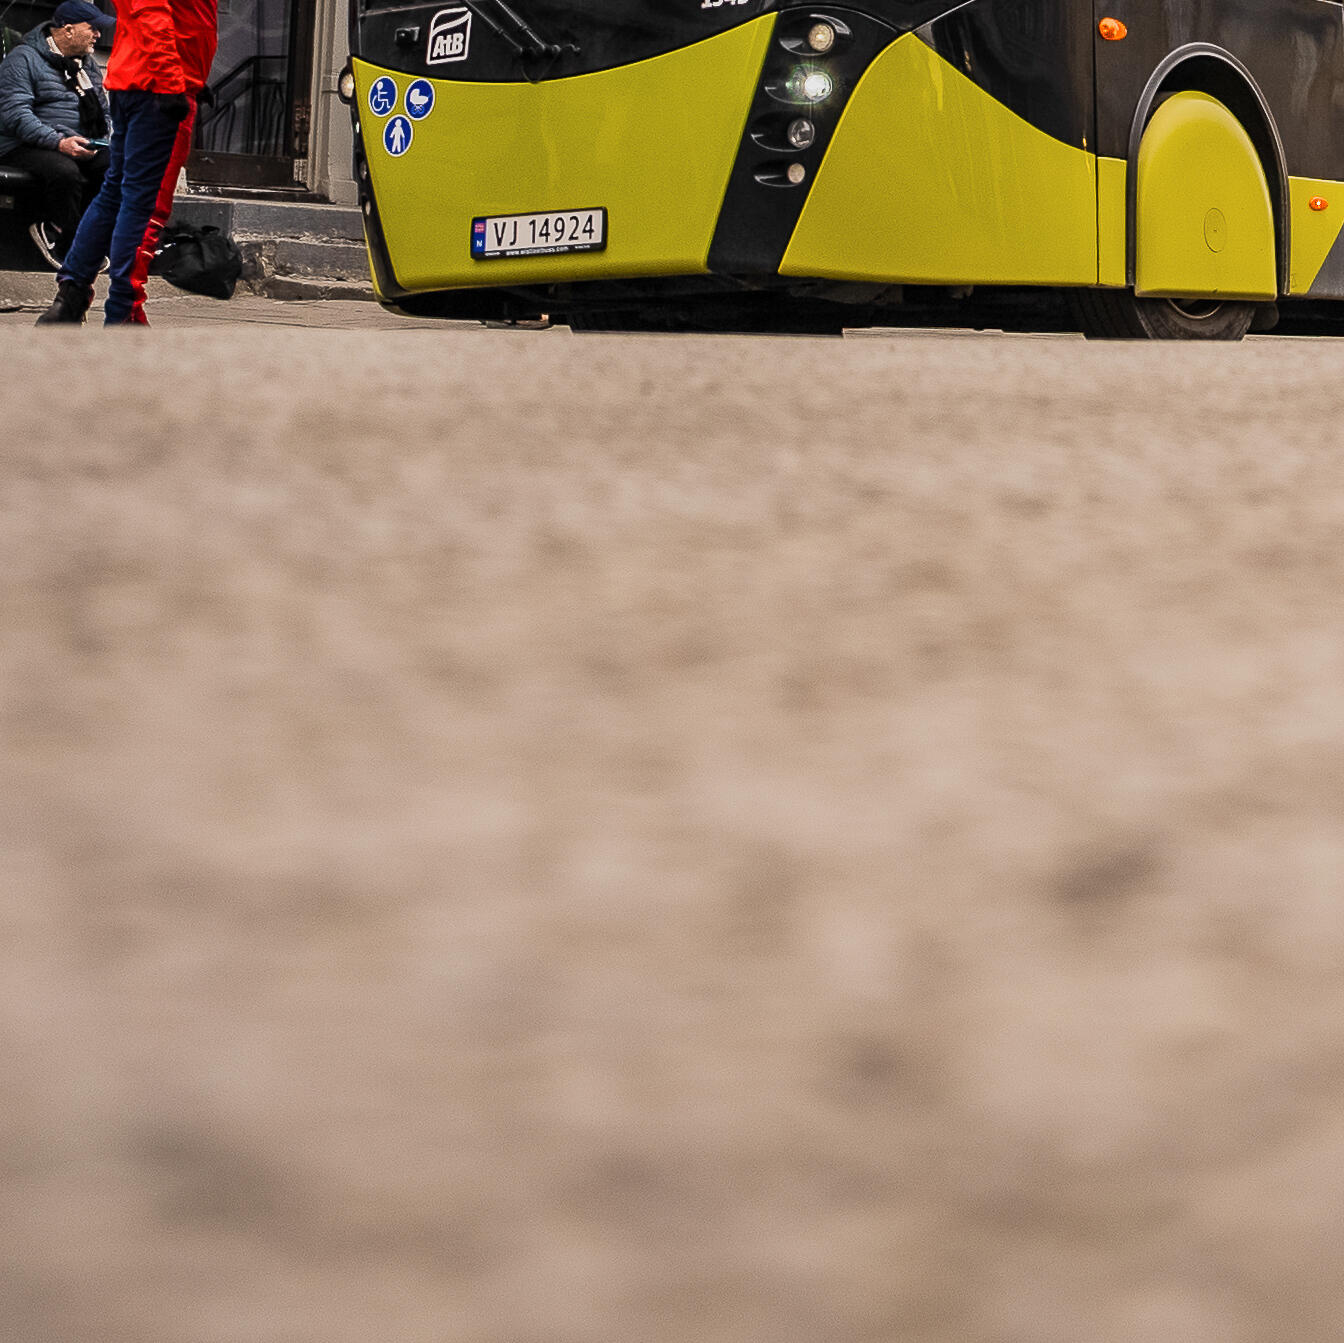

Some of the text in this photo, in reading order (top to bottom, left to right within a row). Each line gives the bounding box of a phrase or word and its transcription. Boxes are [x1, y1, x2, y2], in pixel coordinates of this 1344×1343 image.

[431, 32, 465, 58] AtB
[494, 214, 595, 246] VJ 14924
